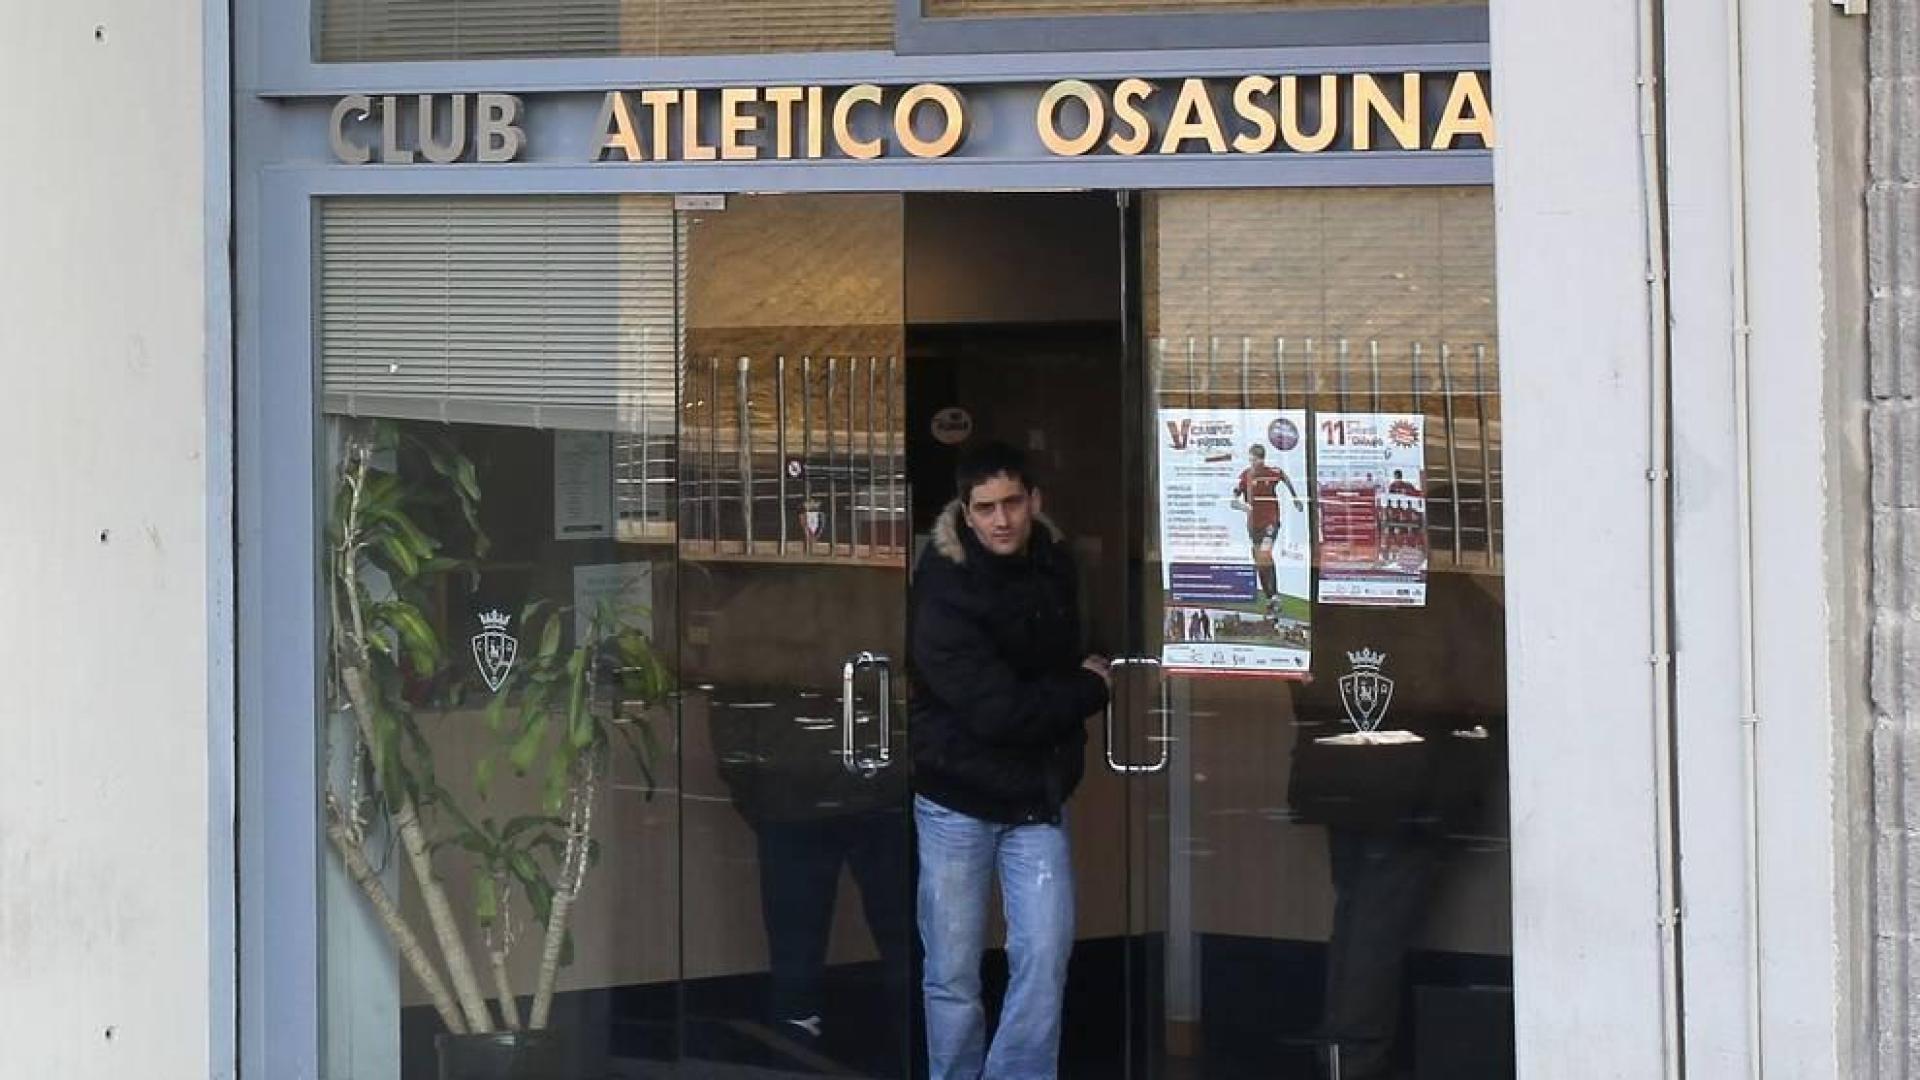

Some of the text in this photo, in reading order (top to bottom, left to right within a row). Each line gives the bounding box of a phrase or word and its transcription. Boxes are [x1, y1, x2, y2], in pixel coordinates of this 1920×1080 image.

[329, 71, 1494, 164] CLUB ATLETICO OSASUNA
[1321, 420, 1344, 445] 11
